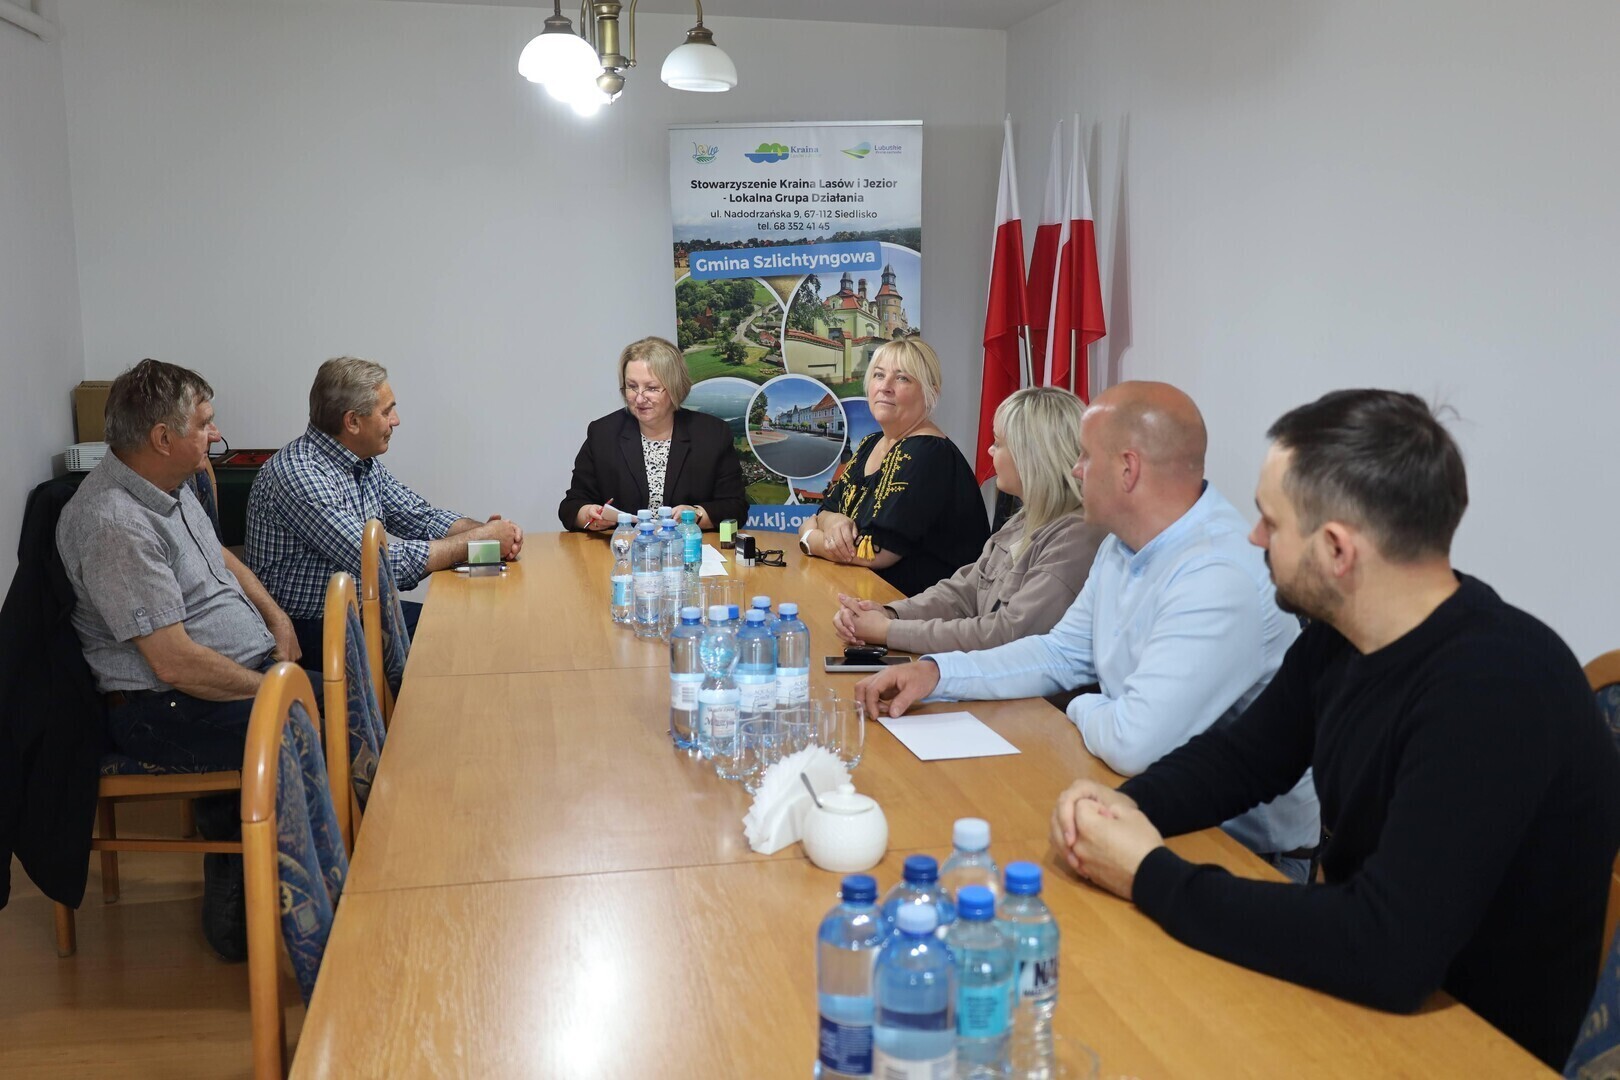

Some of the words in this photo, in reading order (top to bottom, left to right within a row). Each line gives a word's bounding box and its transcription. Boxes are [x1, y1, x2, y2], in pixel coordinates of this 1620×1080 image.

[790, 145, 819, 153] Kraina
[690, 179, 777, 190] Stowarzyszenie
[779, 179, 816, 189] Kraina
[819, 179, 854, 189] Lasów
[857, 178, 861, 188] i
[863, 178, 898, 188] Jezior
[729, 193, 772, 203] Lokalna
[775, 193, 809, 204] Grupa
[811, 192, 865, 203] Działania
[710, 210, 722, 218] ul.
[724, 210, 792, 218] Nadodrzańska
[804, 210, 832, 218] 67-112
[835, 210, 878, 218] Siedlisko
[757, 222, 772, 230] tel.
[773, 222, 786, 230] 68
[788, 222, 804, 230] 352
[806, 222, 816, 230] 41
[818, 222, 830, 230] 45
[695, 256, 750, 272] Gmina
[753, 251, 876, 269] Szlichtyngowa
